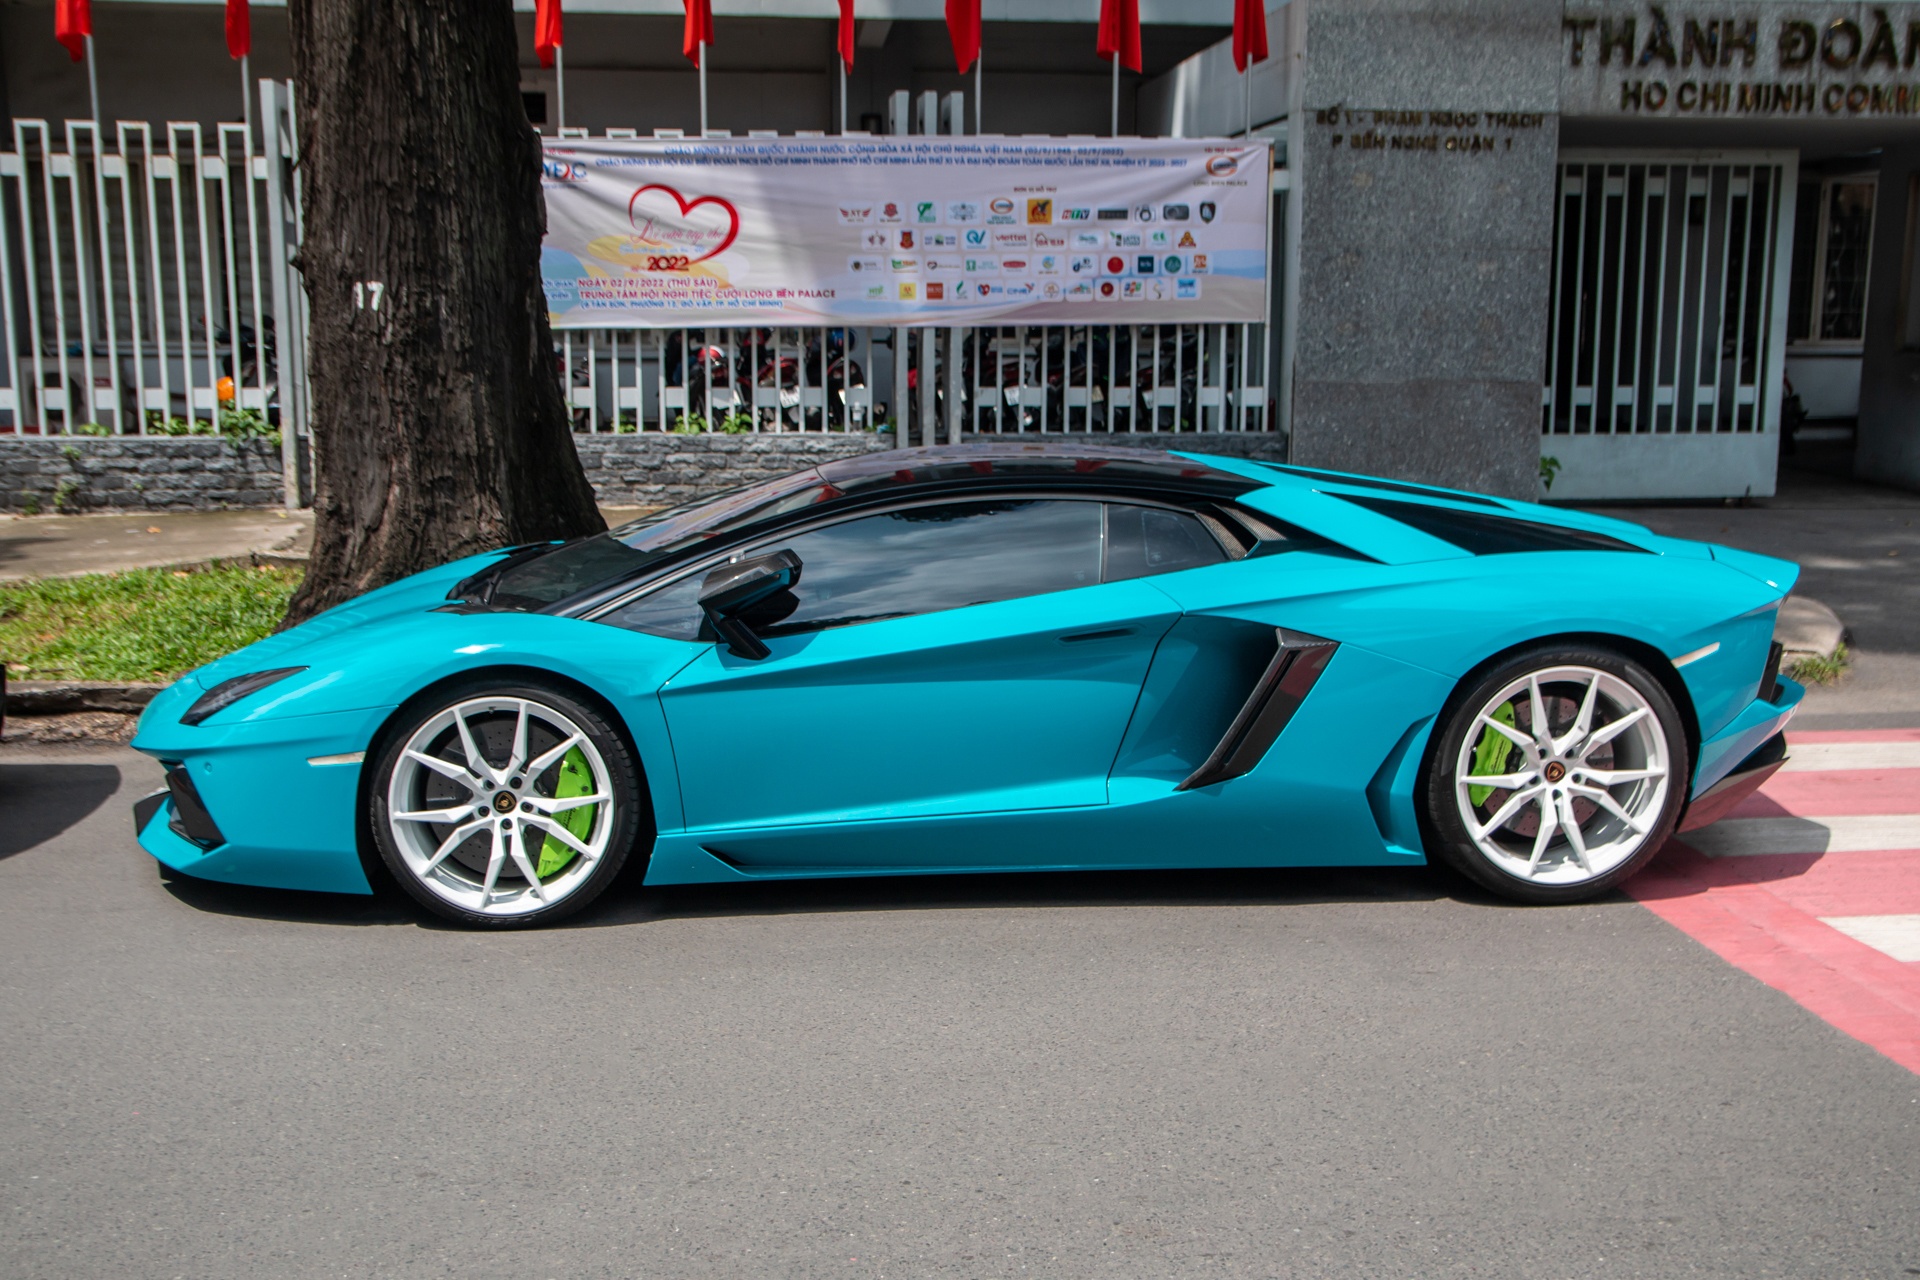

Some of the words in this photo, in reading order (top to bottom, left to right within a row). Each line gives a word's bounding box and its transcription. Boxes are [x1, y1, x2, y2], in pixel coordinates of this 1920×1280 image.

[1563, 5, 1758, 67] THÀNH
[1736, 82, 1815, 113] MINH
[1003, 147, 1022, 155] NAM
[1505, 137, 1513, 151] 1
[647, 256, 689, 272] 2022
[578, 277, 607, 288] NGÀY
[610, 278, 664, 289] 02/9/2022
[667, 277, 690, 289] (THỨ
[694, 277, 718, 289] SÁU)
[353, 281, 385, 312] 17
[580, 290, 614, 300] TRUNG
[617, 288, 638, 299] TÂM
[641, 290, 660, 301] HỘI
[715, 288, 741, 299] CƯỚI
[745, 290, 773, 299] LONG
[799, 290, 836, 299] PALACE
